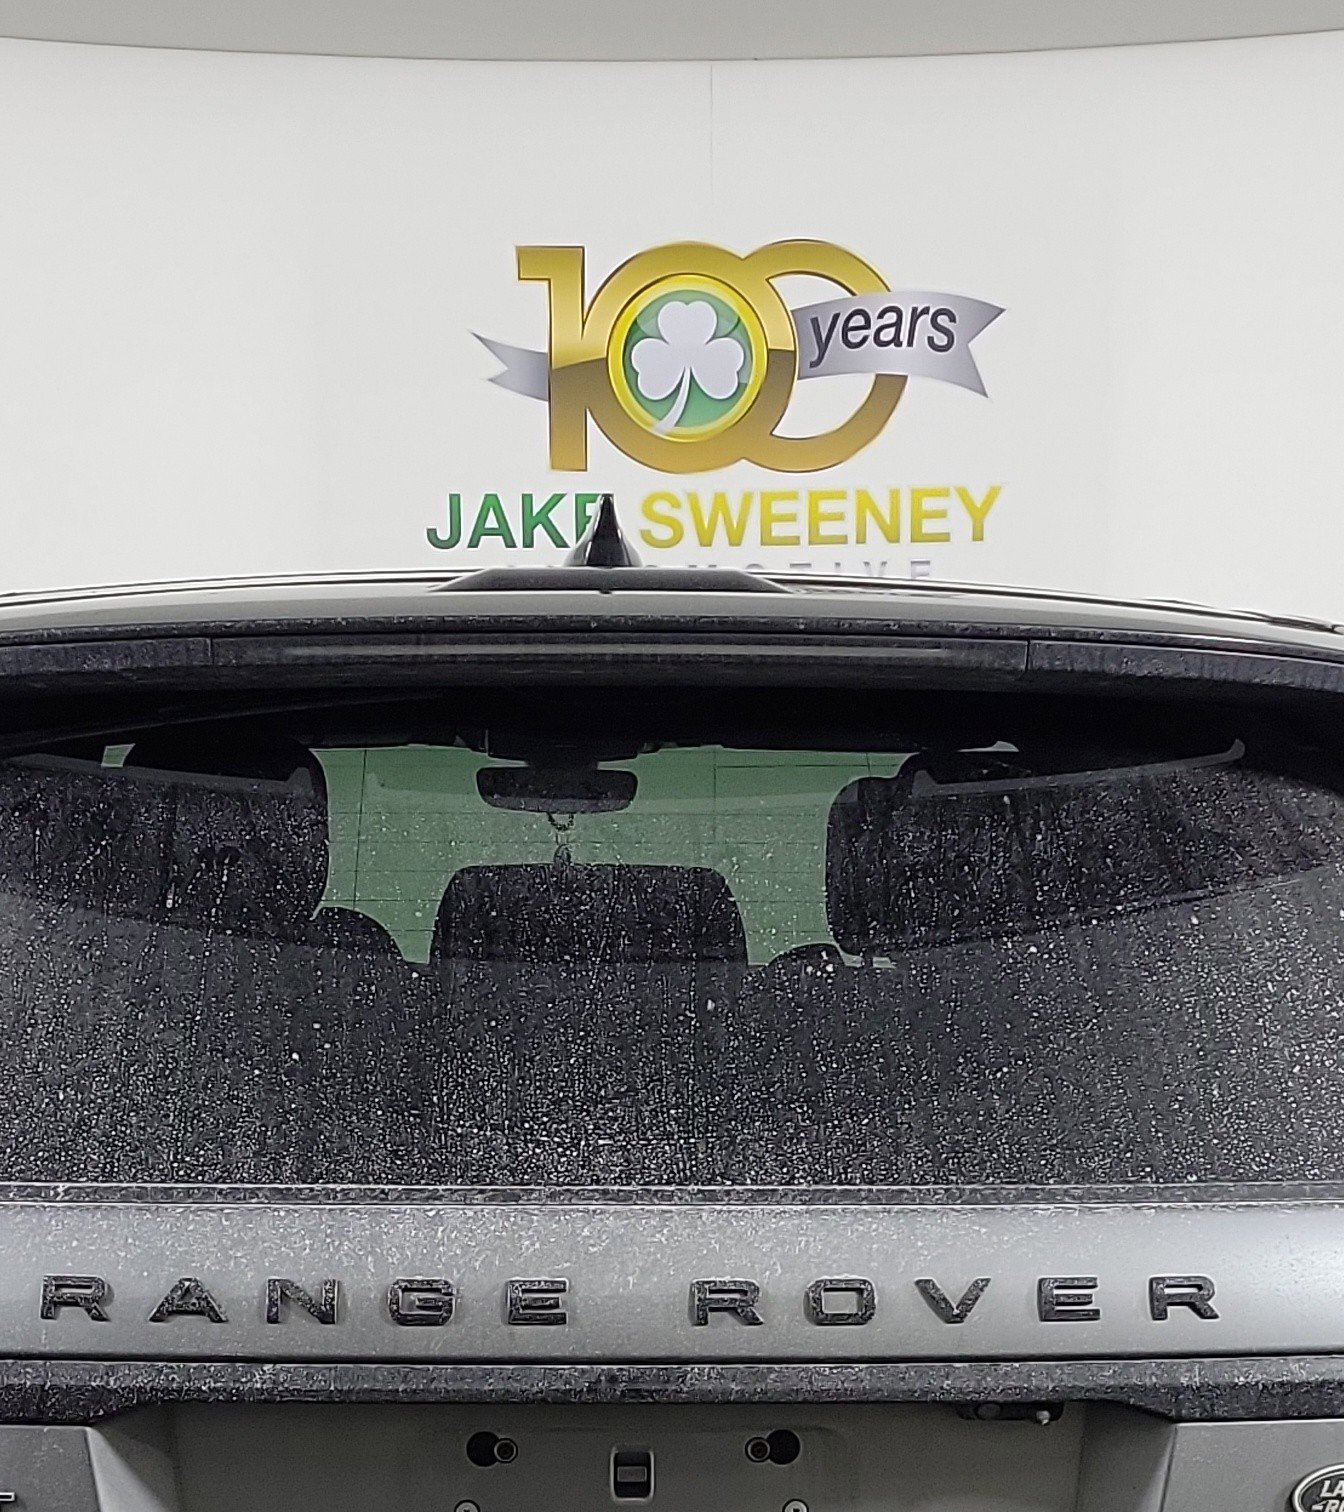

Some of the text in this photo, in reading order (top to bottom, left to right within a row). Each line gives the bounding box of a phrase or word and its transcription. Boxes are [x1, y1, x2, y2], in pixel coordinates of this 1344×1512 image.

[808, 305, 958, 368] years
[639, 485, 1003, 548] SWEENEY
[40, 1275, 1219, 1326] RANGE ROVER
